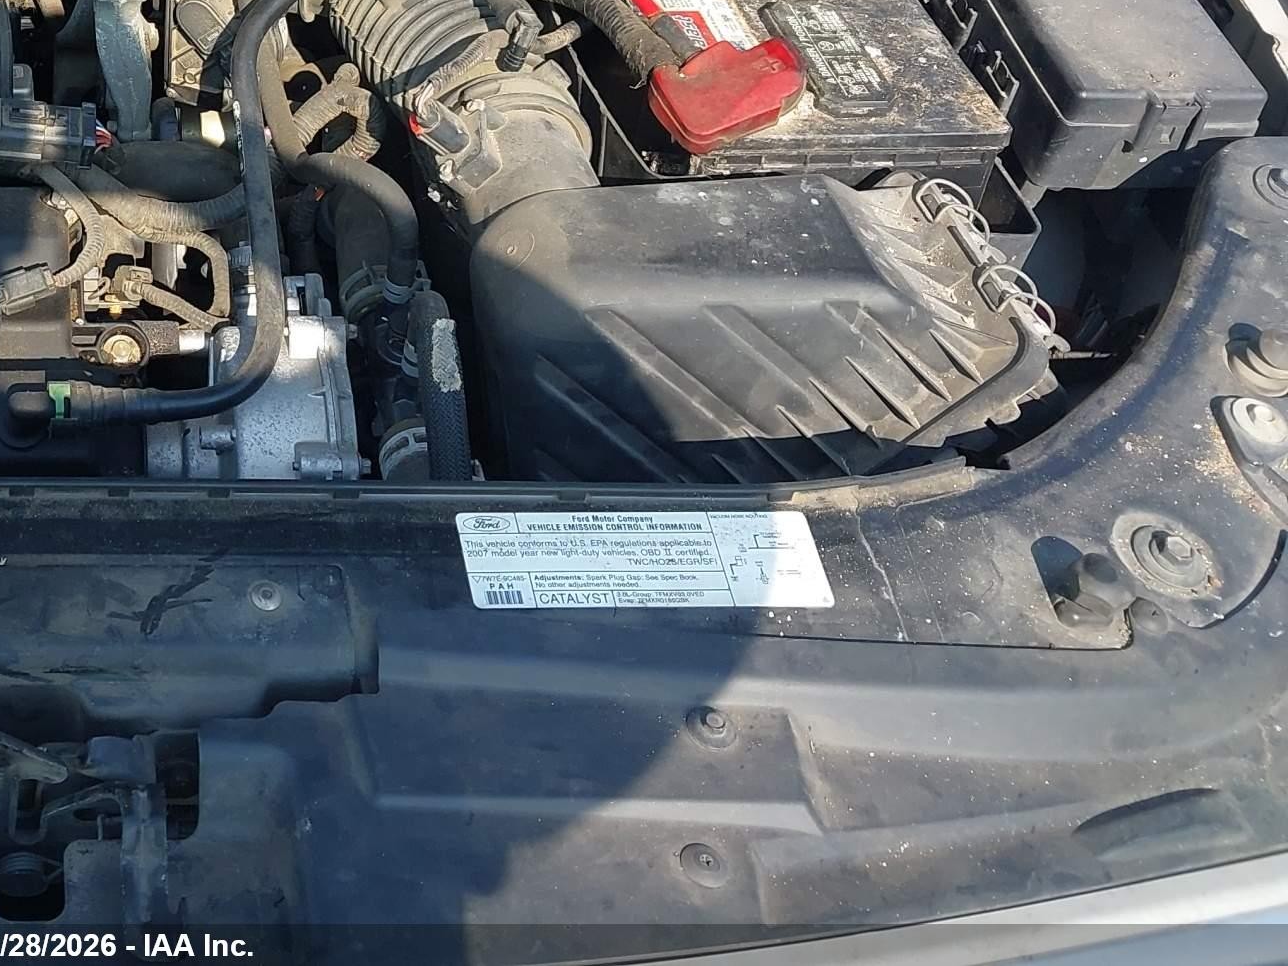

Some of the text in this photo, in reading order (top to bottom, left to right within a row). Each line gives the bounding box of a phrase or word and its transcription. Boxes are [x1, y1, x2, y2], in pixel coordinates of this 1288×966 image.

[472, 518, 501, 528] Ford
[616, 515, 653, 523] Company
[609, 539, 657, 547] regulations
[658, 539, 701, 547] applicable
[560, 549, 600, 557] light-duty
[538, 593, 611, 603] CATALYST
